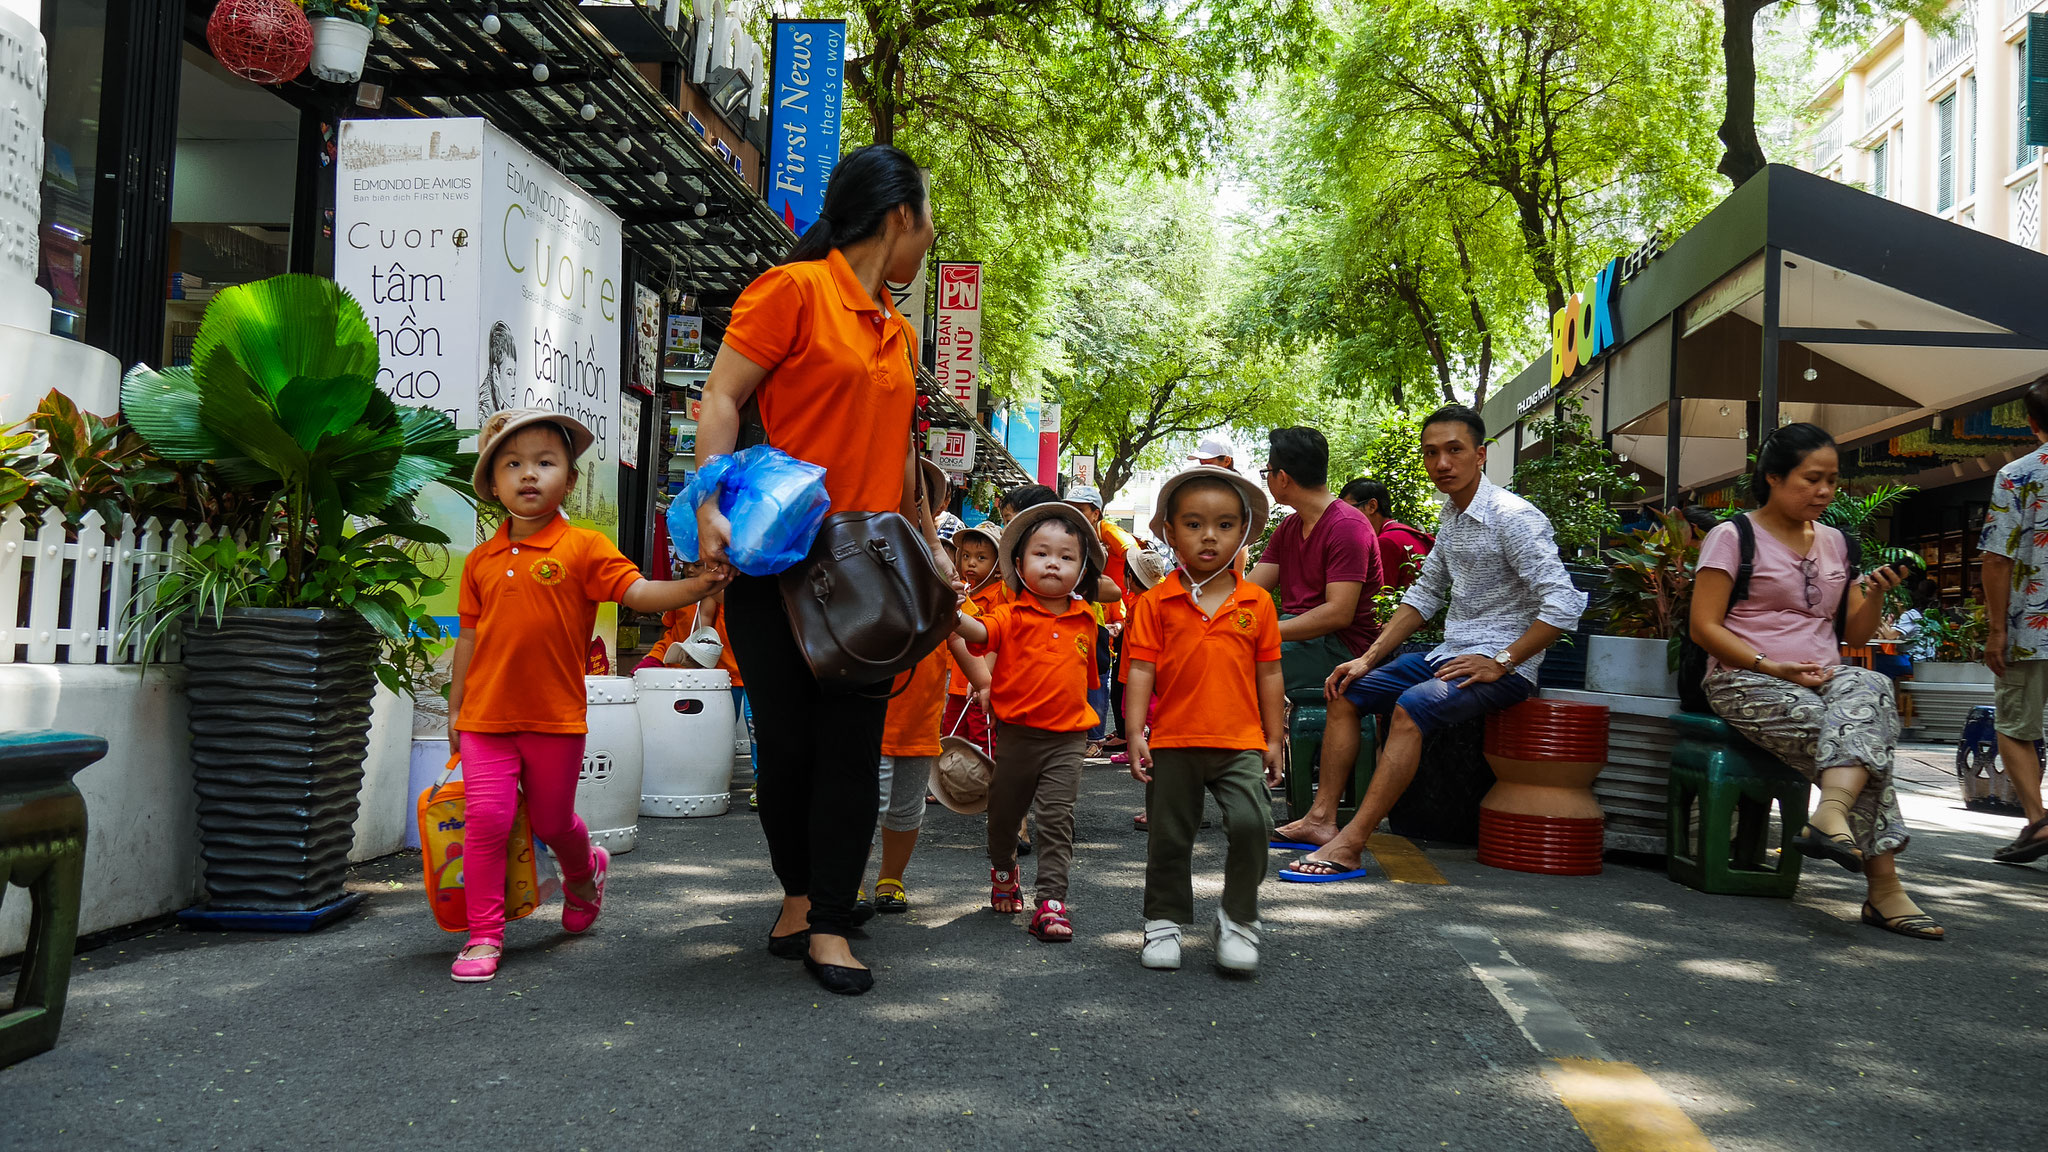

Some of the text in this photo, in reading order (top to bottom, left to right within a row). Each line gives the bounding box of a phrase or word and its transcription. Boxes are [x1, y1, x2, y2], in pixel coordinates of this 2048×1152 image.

[827, 28, 843, 62] way
[826, 67, 837, 78] a
[821, 82, 836, 136] there's
[353, 177, 472, 191] EDMONDO DE AMICIS
[775, 121, 807, 197] First
[817, 154, 832, 184] will
[353, 194, 370, 202] Ban
[372, 193, 390, 201] biên
[413, 192, 439, 201] FIRST
[442, 192, 470, 200] NEWS
[506, 162, 556, 218] EDMONDO
[348, 221, 469, 249] Cuore
[371, 262, 446, 304] tâm
[503, 203, 615, 323] Cuore
[374, 304, 443, 357] hồn
[1551, 257, 1616, 389] BOOK
[534, 326, 607, 404] tâm hồn
[953, 326, 976, 407] HỤ NỮ
